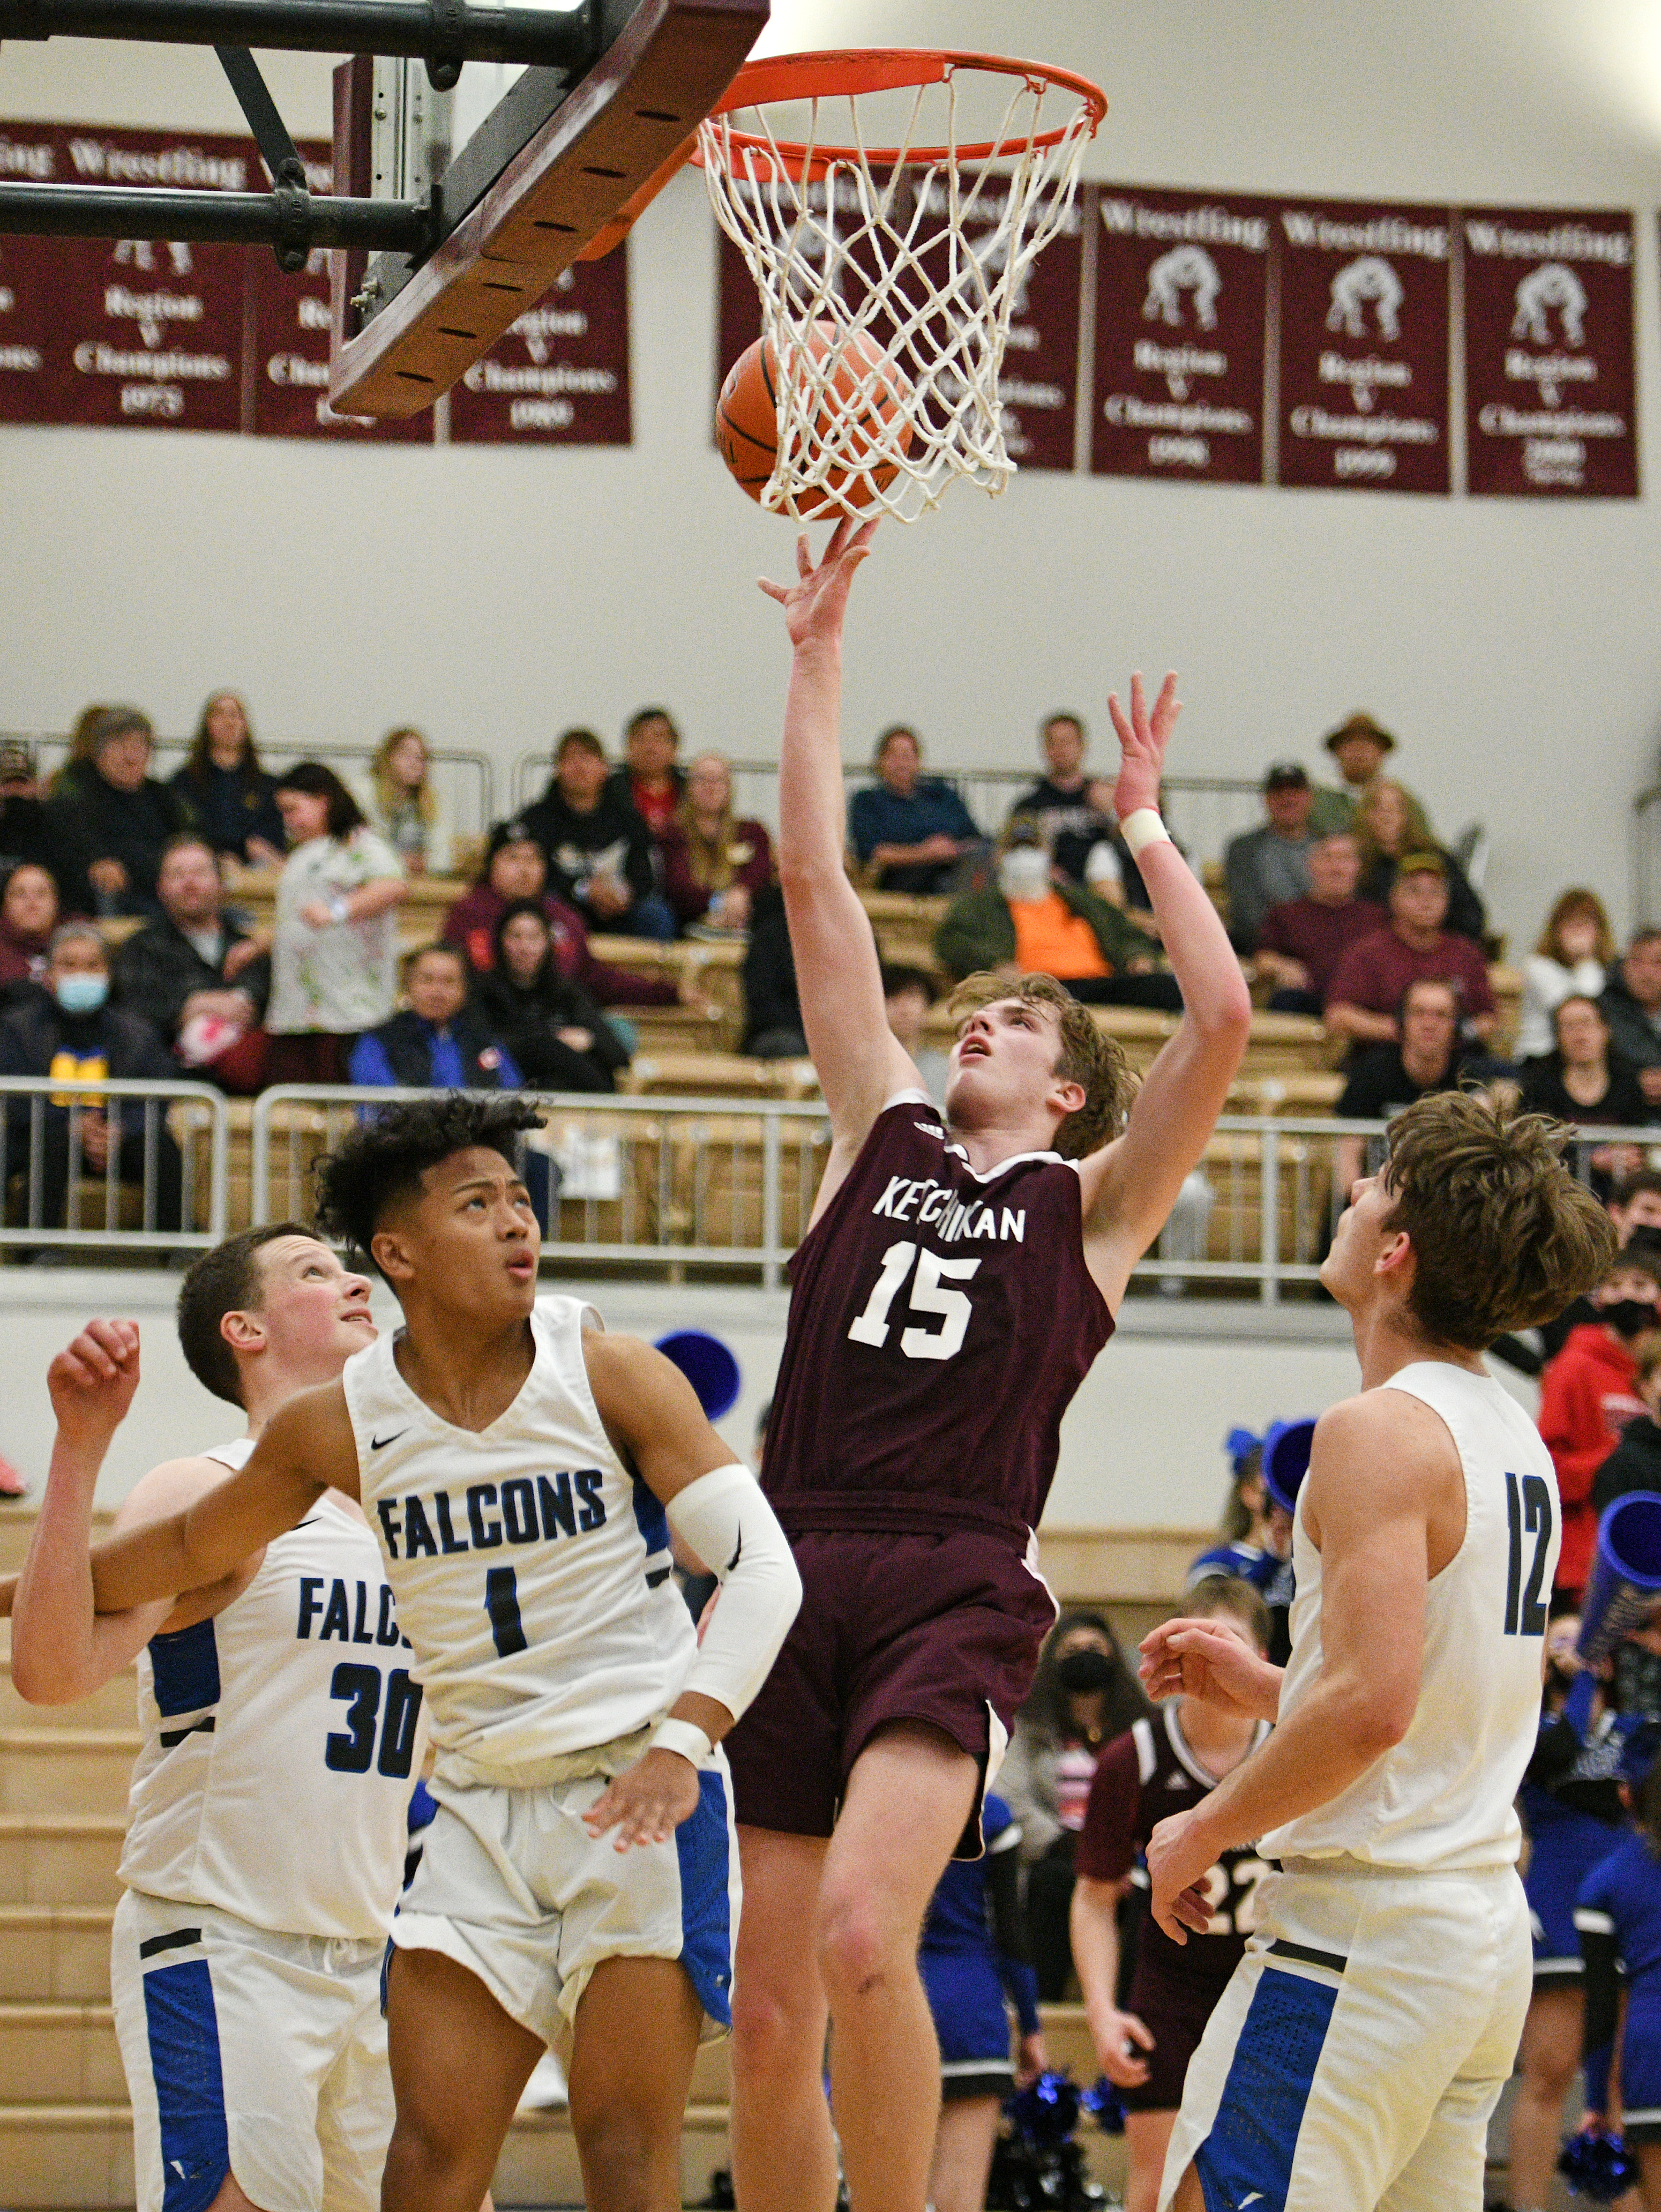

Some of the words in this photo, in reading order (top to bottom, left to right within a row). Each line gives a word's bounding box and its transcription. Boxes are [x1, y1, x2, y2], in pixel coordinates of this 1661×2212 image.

[1101, 197, 1270, 252] Wrestling
[1283, 211, 1448, 261] Wrestling
[1466, 220, 1630, 266] Wrestling
[73, 341, 233, 384] Champions
[1103, 393, 1254, 435] Champions
[1290, 405, 1439, 447] Champions
[1478, 402, 1627, 439] Champions
[847, 1240, 982, 1361] 15
[377, 1469, 607, 1559] FALCONS
[1504, 1471, 1552, 1636] 12
[296, 1577, 413, 1649] FALC
[484, 1566, 528, 1658] 1
[325, 1662, 423, 1779] 30
